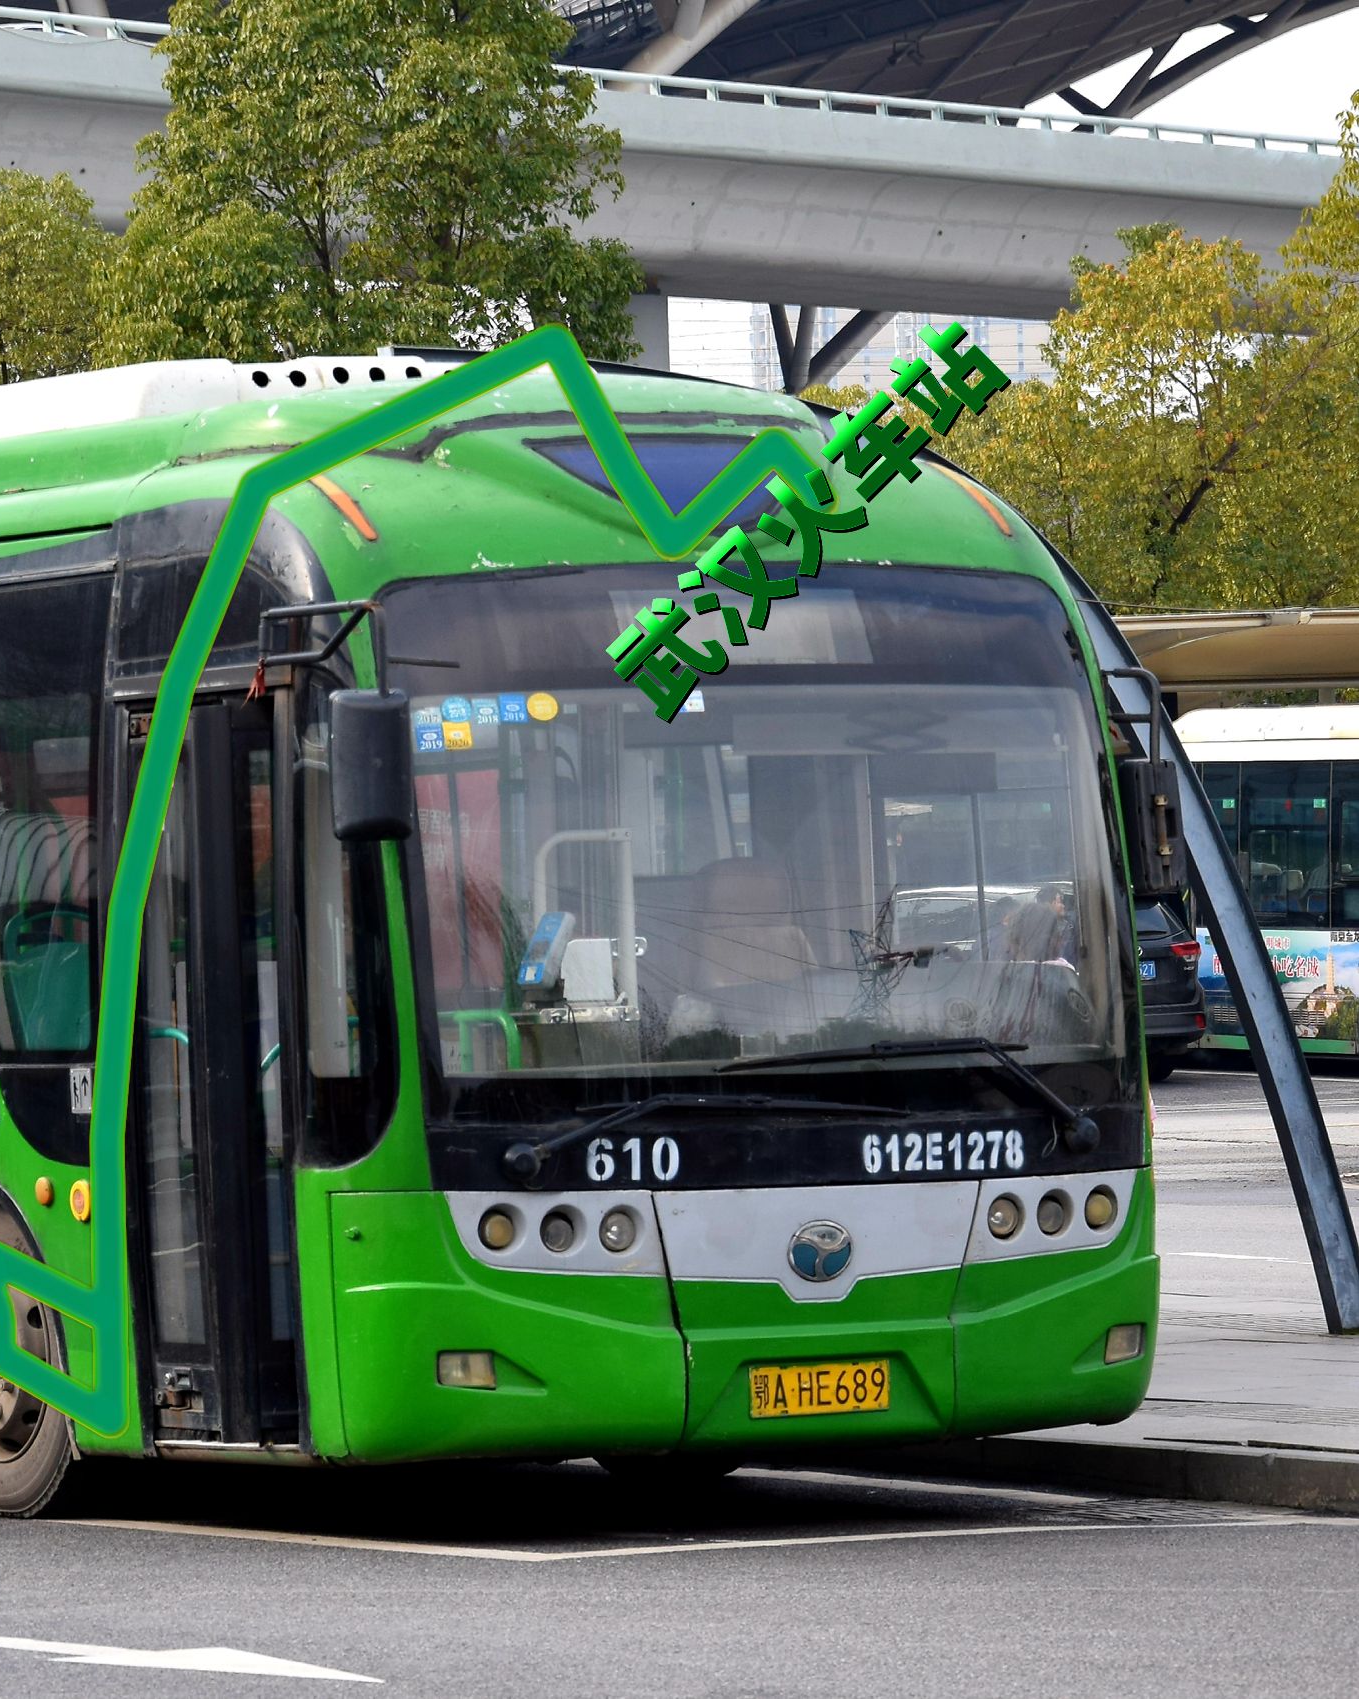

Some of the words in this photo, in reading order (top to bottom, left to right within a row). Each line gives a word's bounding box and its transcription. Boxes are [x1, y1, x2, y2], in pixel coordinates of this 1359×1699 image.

[503, 711, 525, 721] 2019
[420, 740, 443, 750] 2019
[586, 1137, 680, 1182] 610
[862, 1129, 1026, 1174] 612E1278
